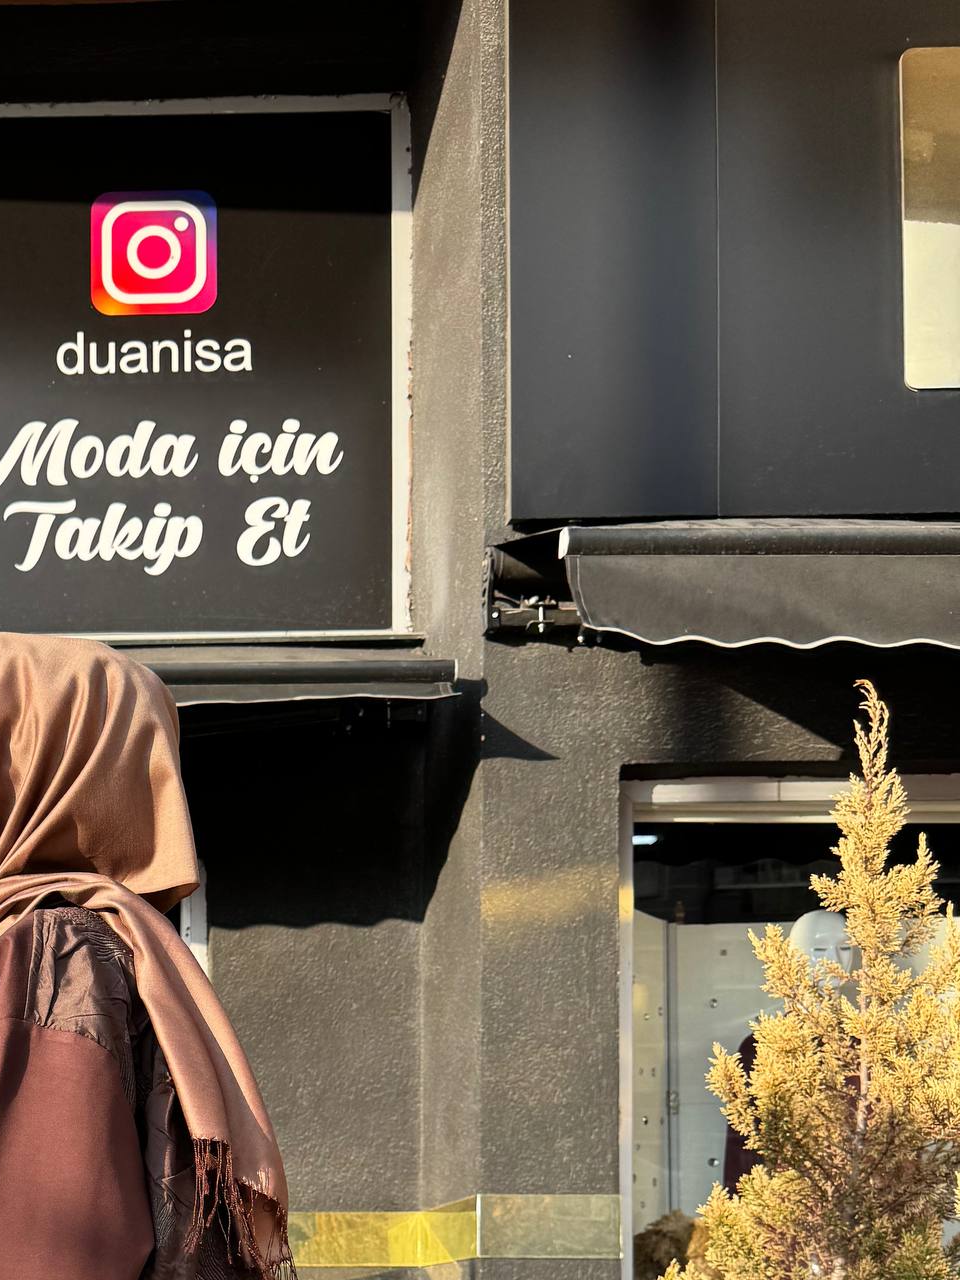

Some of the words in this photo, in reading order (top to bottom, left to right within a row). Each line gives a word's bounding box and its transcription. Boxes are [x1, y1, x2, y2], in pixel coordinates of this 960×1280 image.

[55, 328, 254, 375] duanisa
[217, 418, 344, 484] için
[3, 499, 204, 576] Takip
[236, 496, 312, 567] Et
